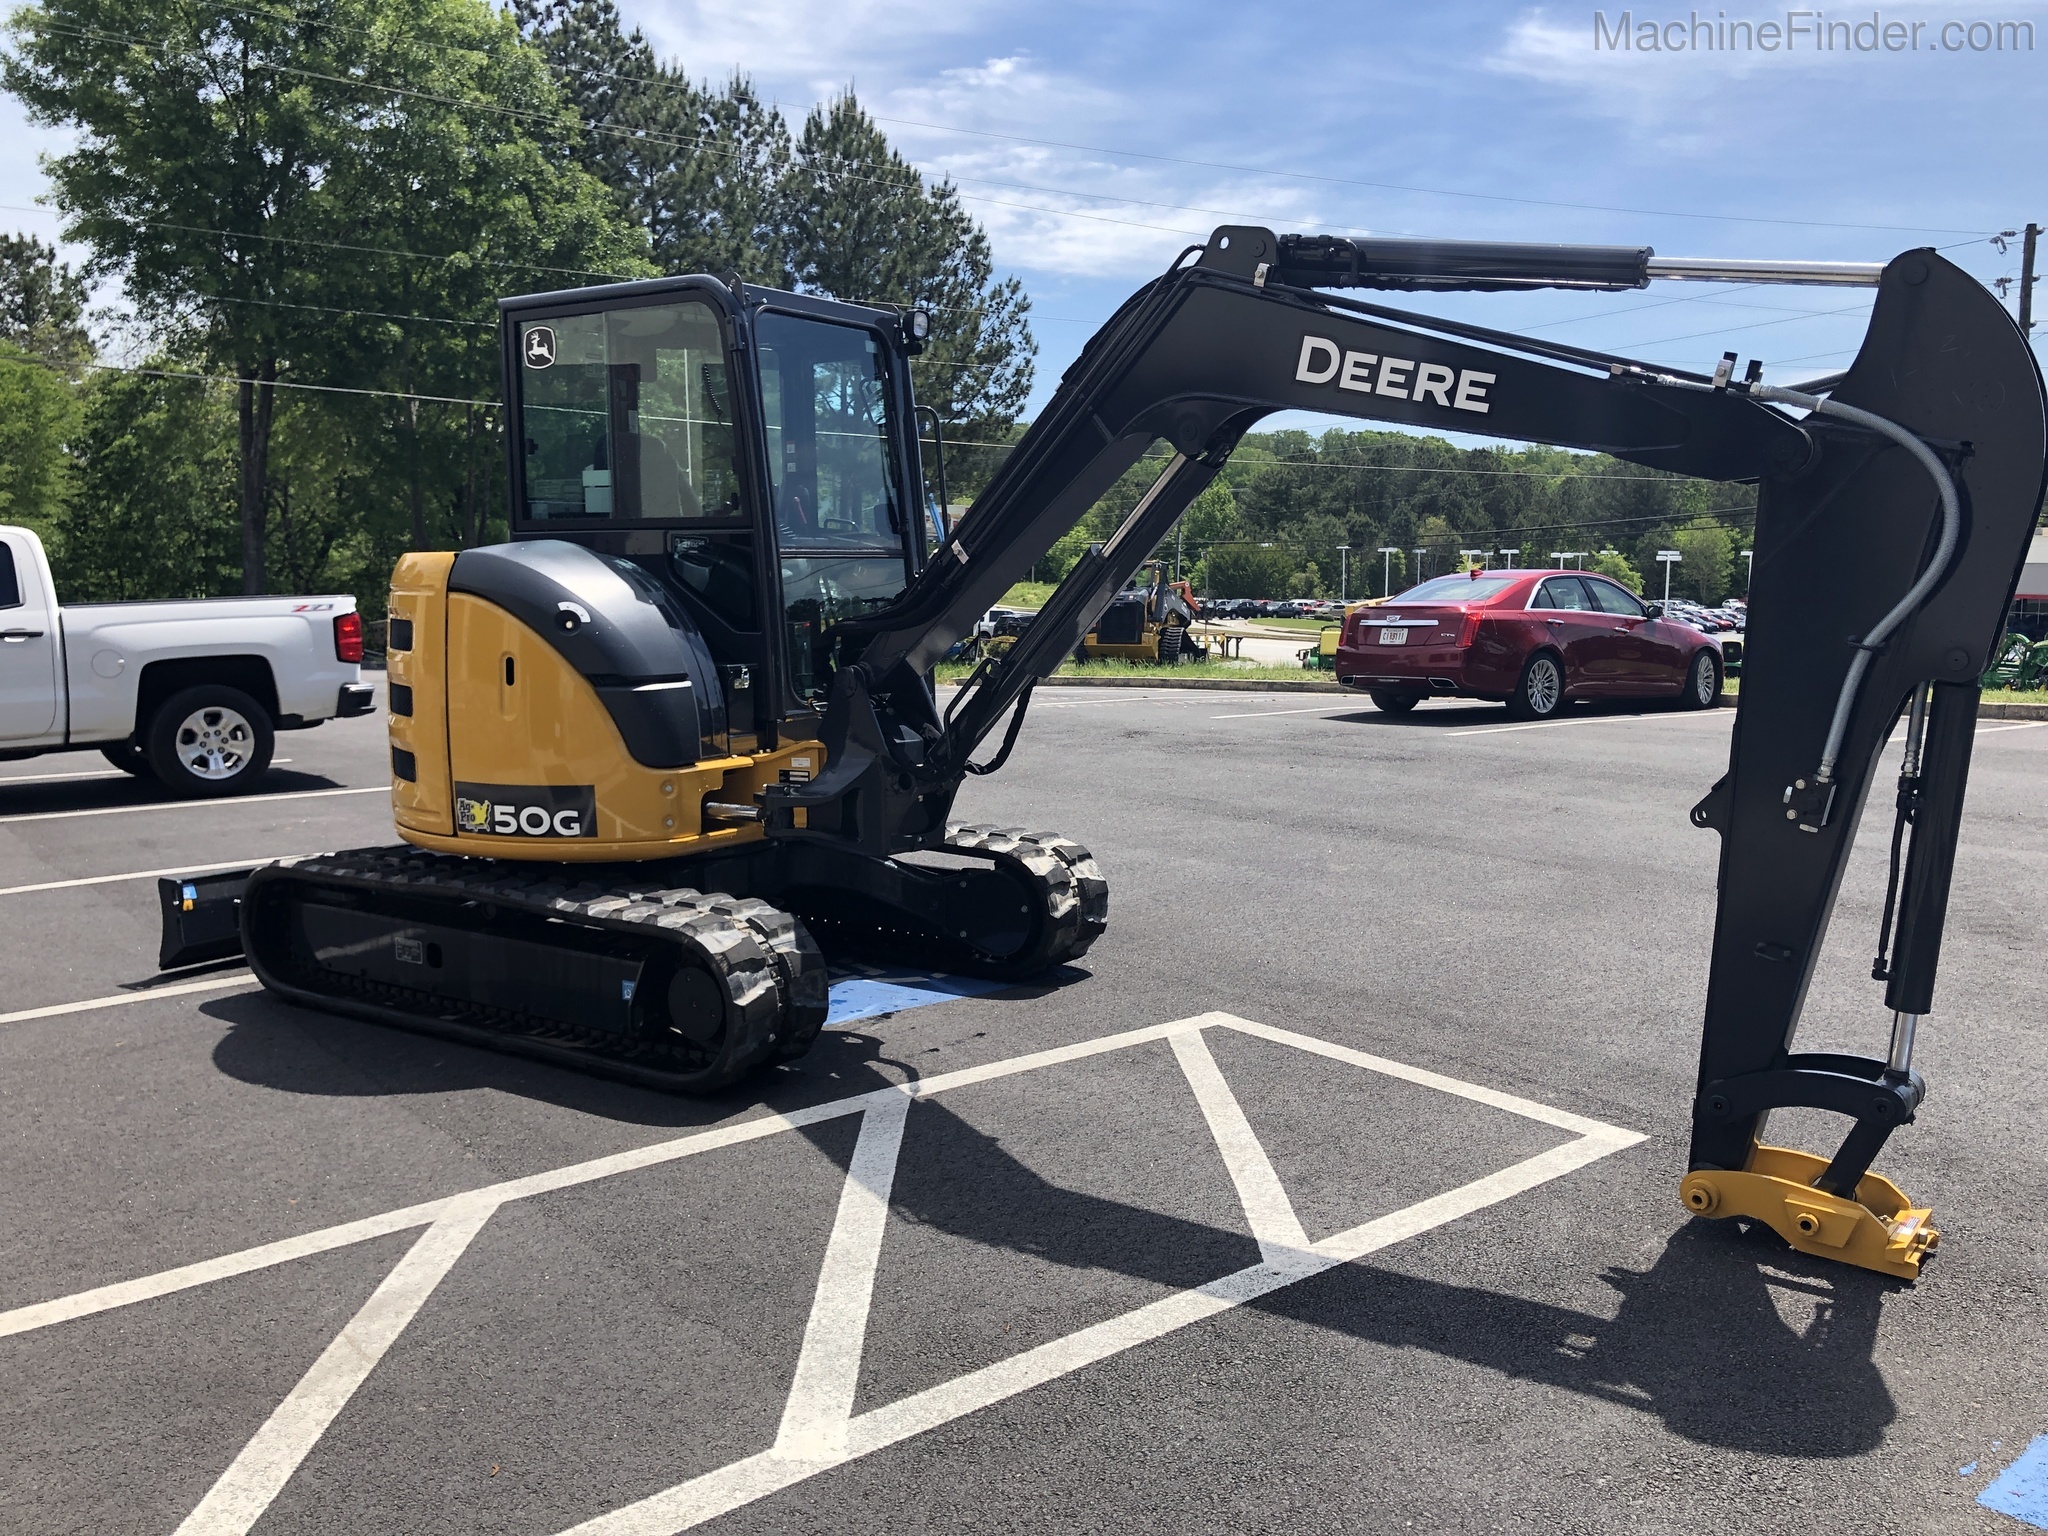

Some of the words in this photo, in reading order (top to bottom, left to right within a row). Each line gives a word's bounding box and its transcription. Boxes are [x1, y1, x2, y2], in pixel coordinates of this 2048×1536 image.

[1295, 335, 1497, 413] DEERE
[291, 604, 334, 612] Z71
[460, 811, 475, 823] Pro
[493, 805, 581, 836] 50G
